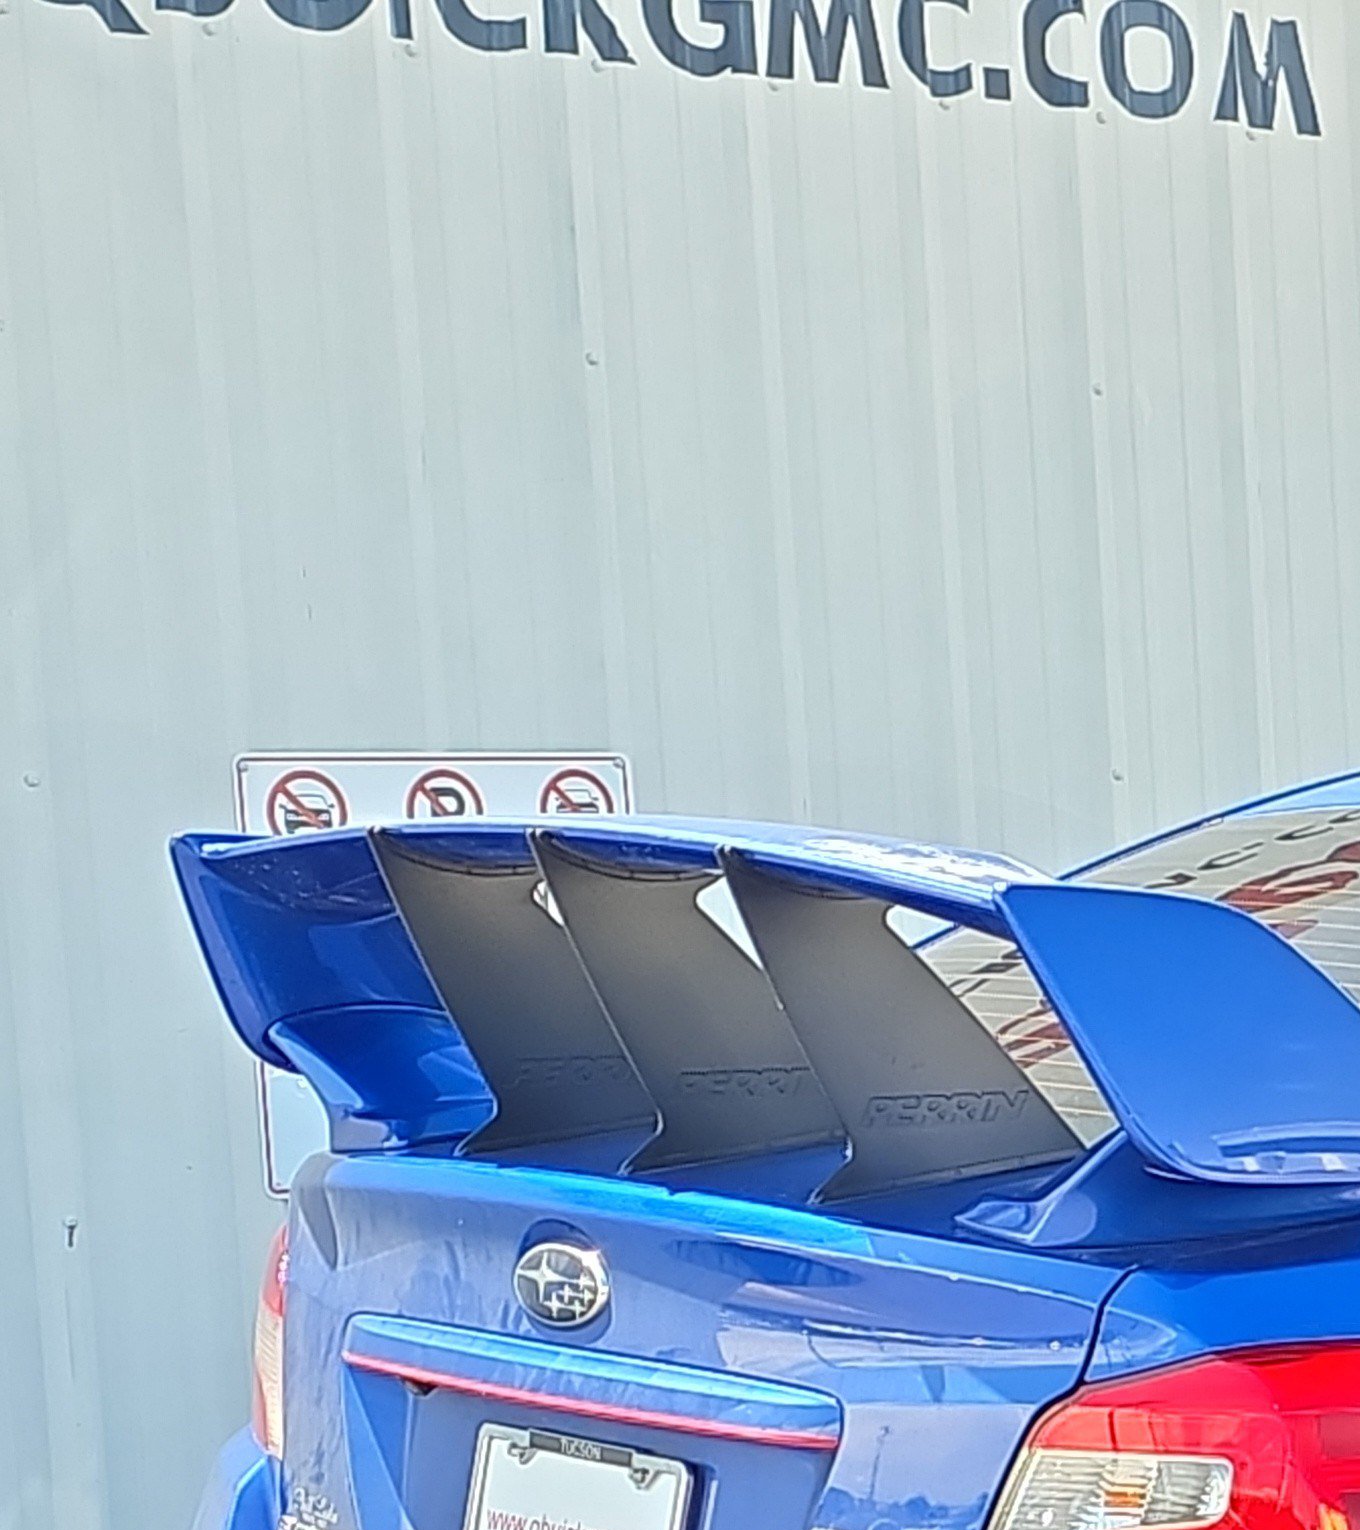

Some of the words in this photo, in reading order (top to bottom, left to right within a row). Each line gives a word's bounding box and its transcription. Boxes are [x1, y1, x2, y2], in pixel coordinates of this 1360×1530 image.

[40, 0, 1322, 137] GMC.COM
[864, 1091, 1030, 1127] PERRIN
[559, 1437, 602, 1460] TUCSON
